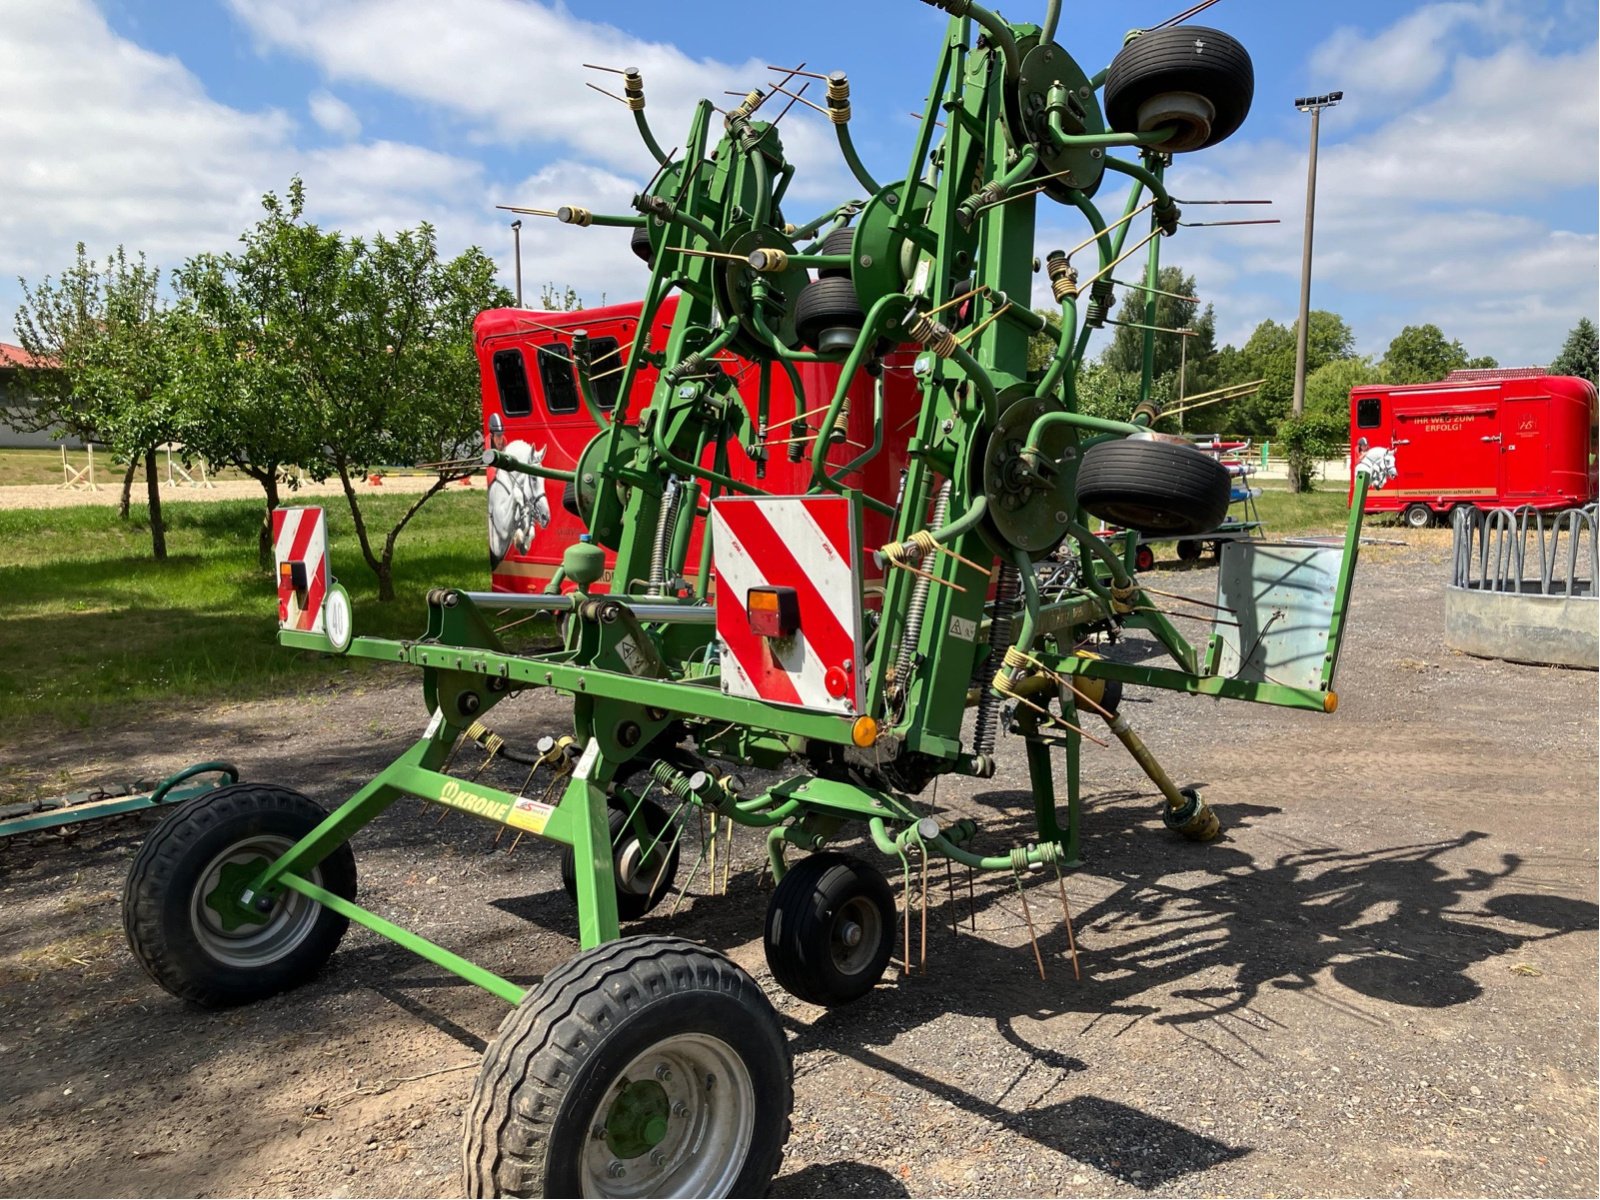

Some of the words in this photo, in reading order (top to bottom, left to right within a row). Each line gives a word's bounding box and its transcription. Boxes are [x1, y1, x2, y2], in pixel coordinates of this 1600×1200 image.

[1414, 416, 1428, 425] IHR
[1431, 415, 1452, 424] WEG
[1454, 414, 1475, 423] ZUM
[1425, 423, 1462, 432] ERFOLG!
[332, 602, 344, 635] 40
[453, 790, 510, 821] KRONE
